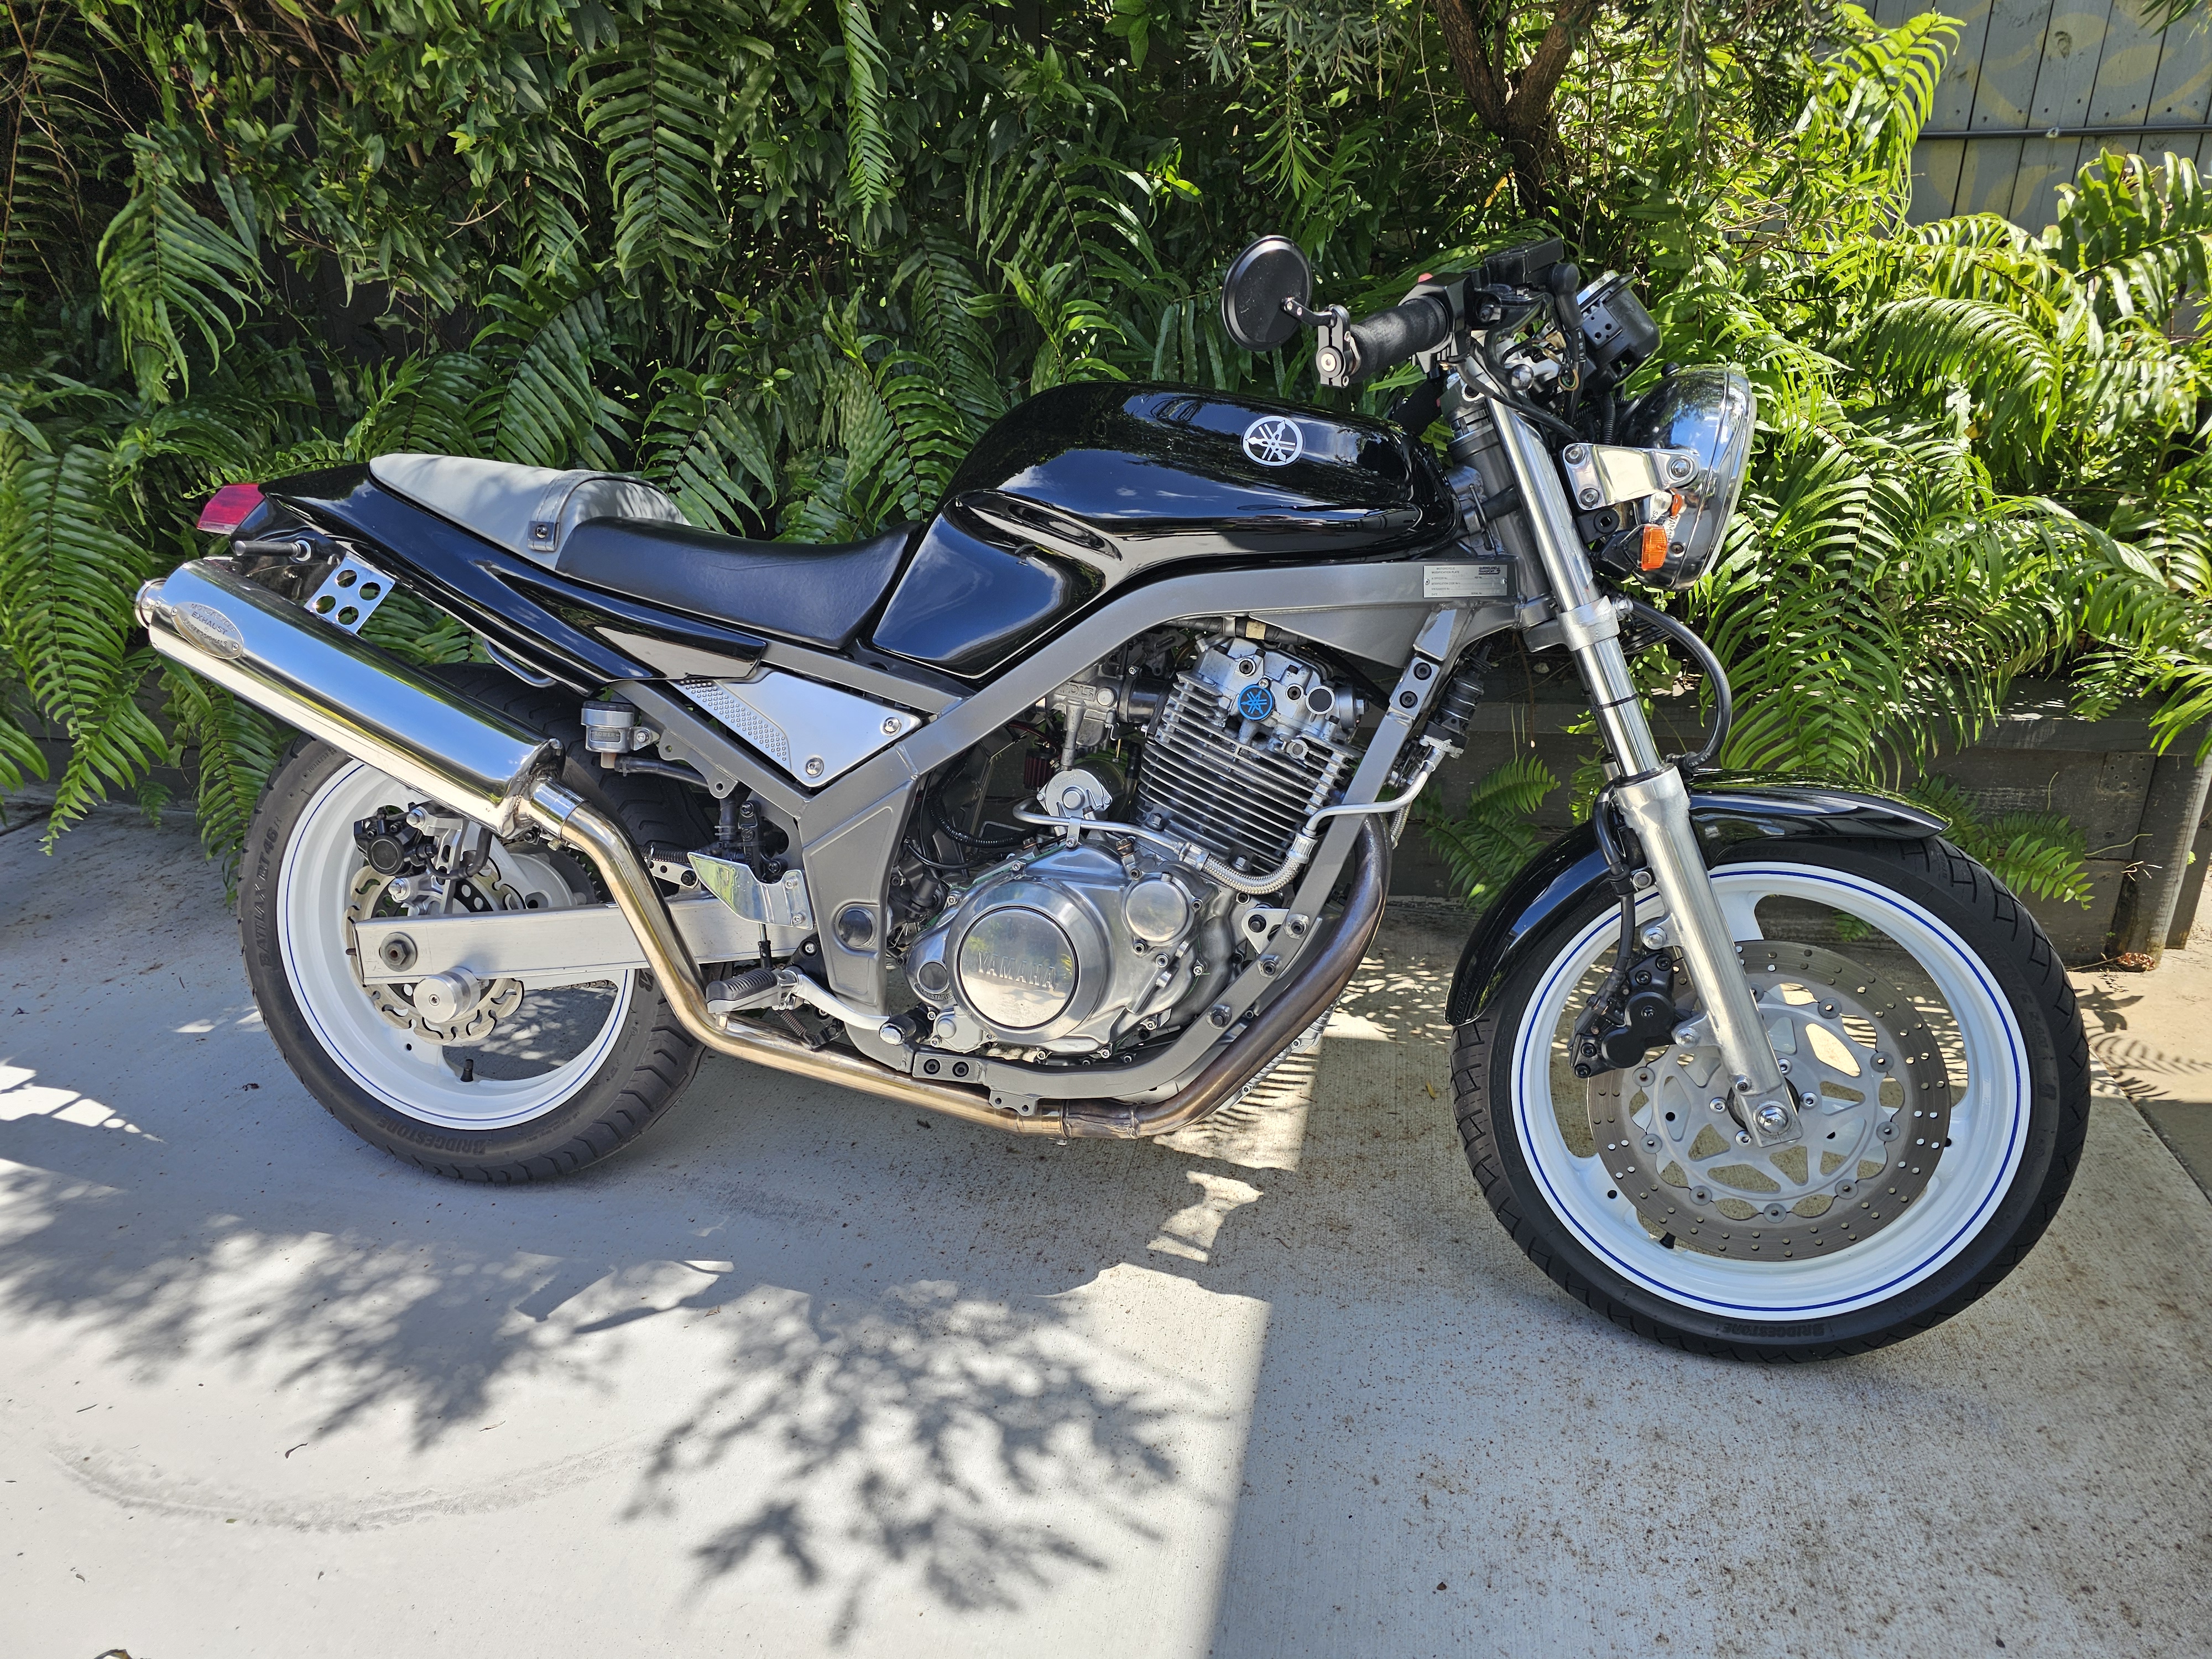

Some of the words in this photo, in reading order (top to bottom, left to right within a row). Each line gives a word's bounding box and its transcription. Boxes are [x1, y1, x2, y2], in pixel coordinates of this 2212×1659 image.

[189, 603, 237, 632] MOTORCYCLE
[191, 612, 228, 635] EXHAUST
[182, 618, 228, 648] PROFESSIONALS
[254, 883, 273, 968] BATTLAX
[977, 950, 1056, 989] YAMAHA
[931, 992, 953, 1000] STARTE
[377, 1114, 490, 1156] BRIDGESTONE
[1721, 1322, 1827, 1338] BRIDGESTONE
